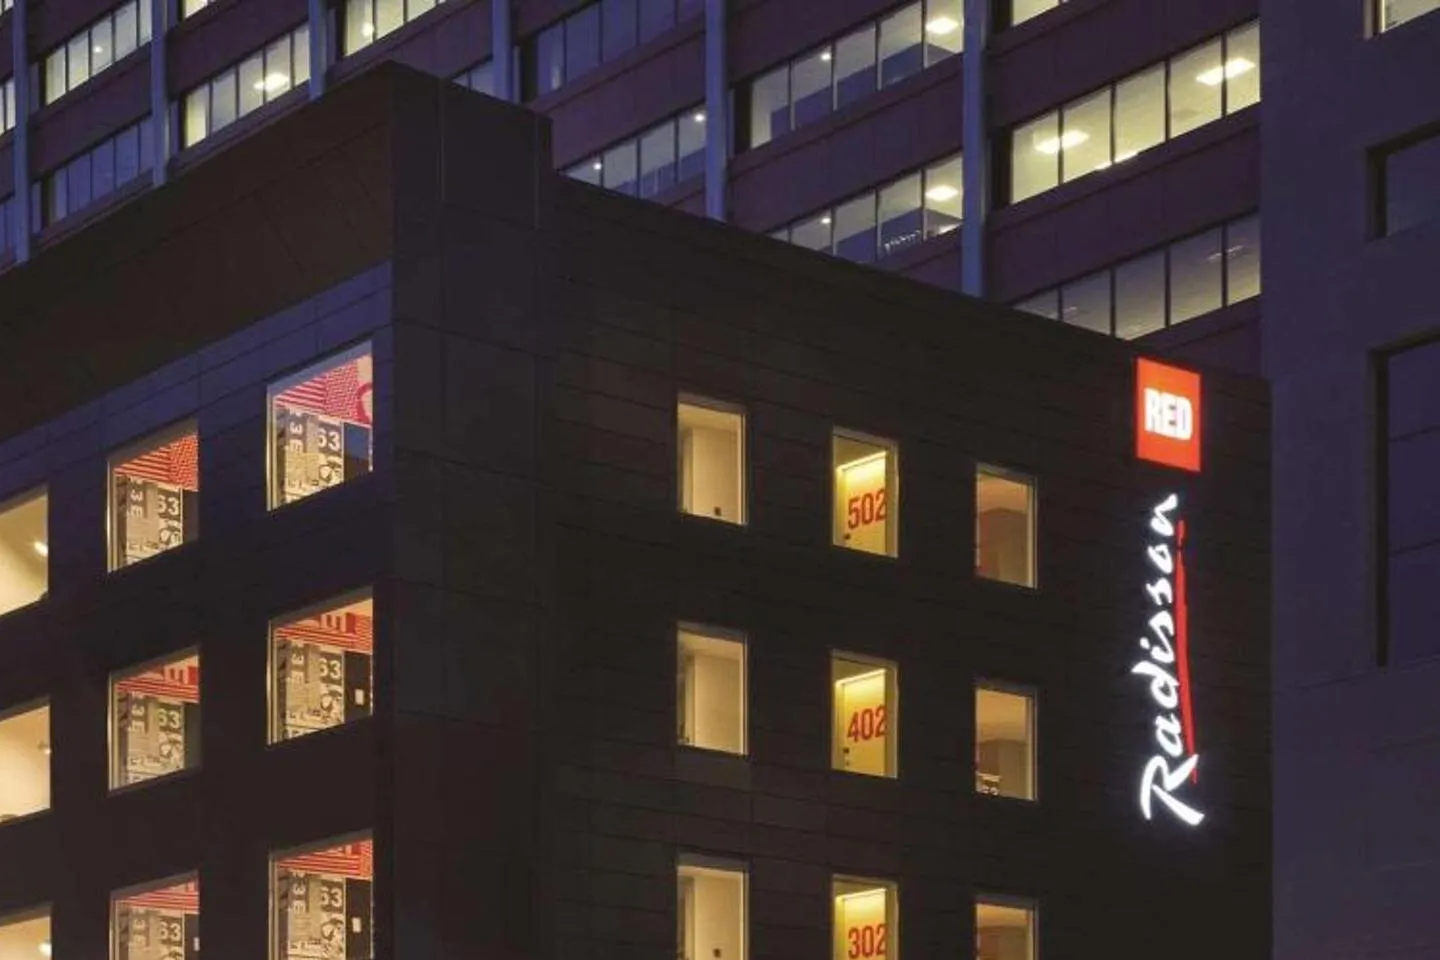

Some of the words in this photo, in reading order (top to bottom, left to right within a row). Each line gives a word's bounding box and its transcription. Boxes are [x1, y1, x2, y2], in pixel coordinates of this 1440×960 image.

[1144, 387, 1193, 440] RED
[848, 489, 887, 530] 502
[1131, 494, 1204, 826] Radisson
[847, 704, 887, 743] 402
[848, 923, 887, 960] 302
